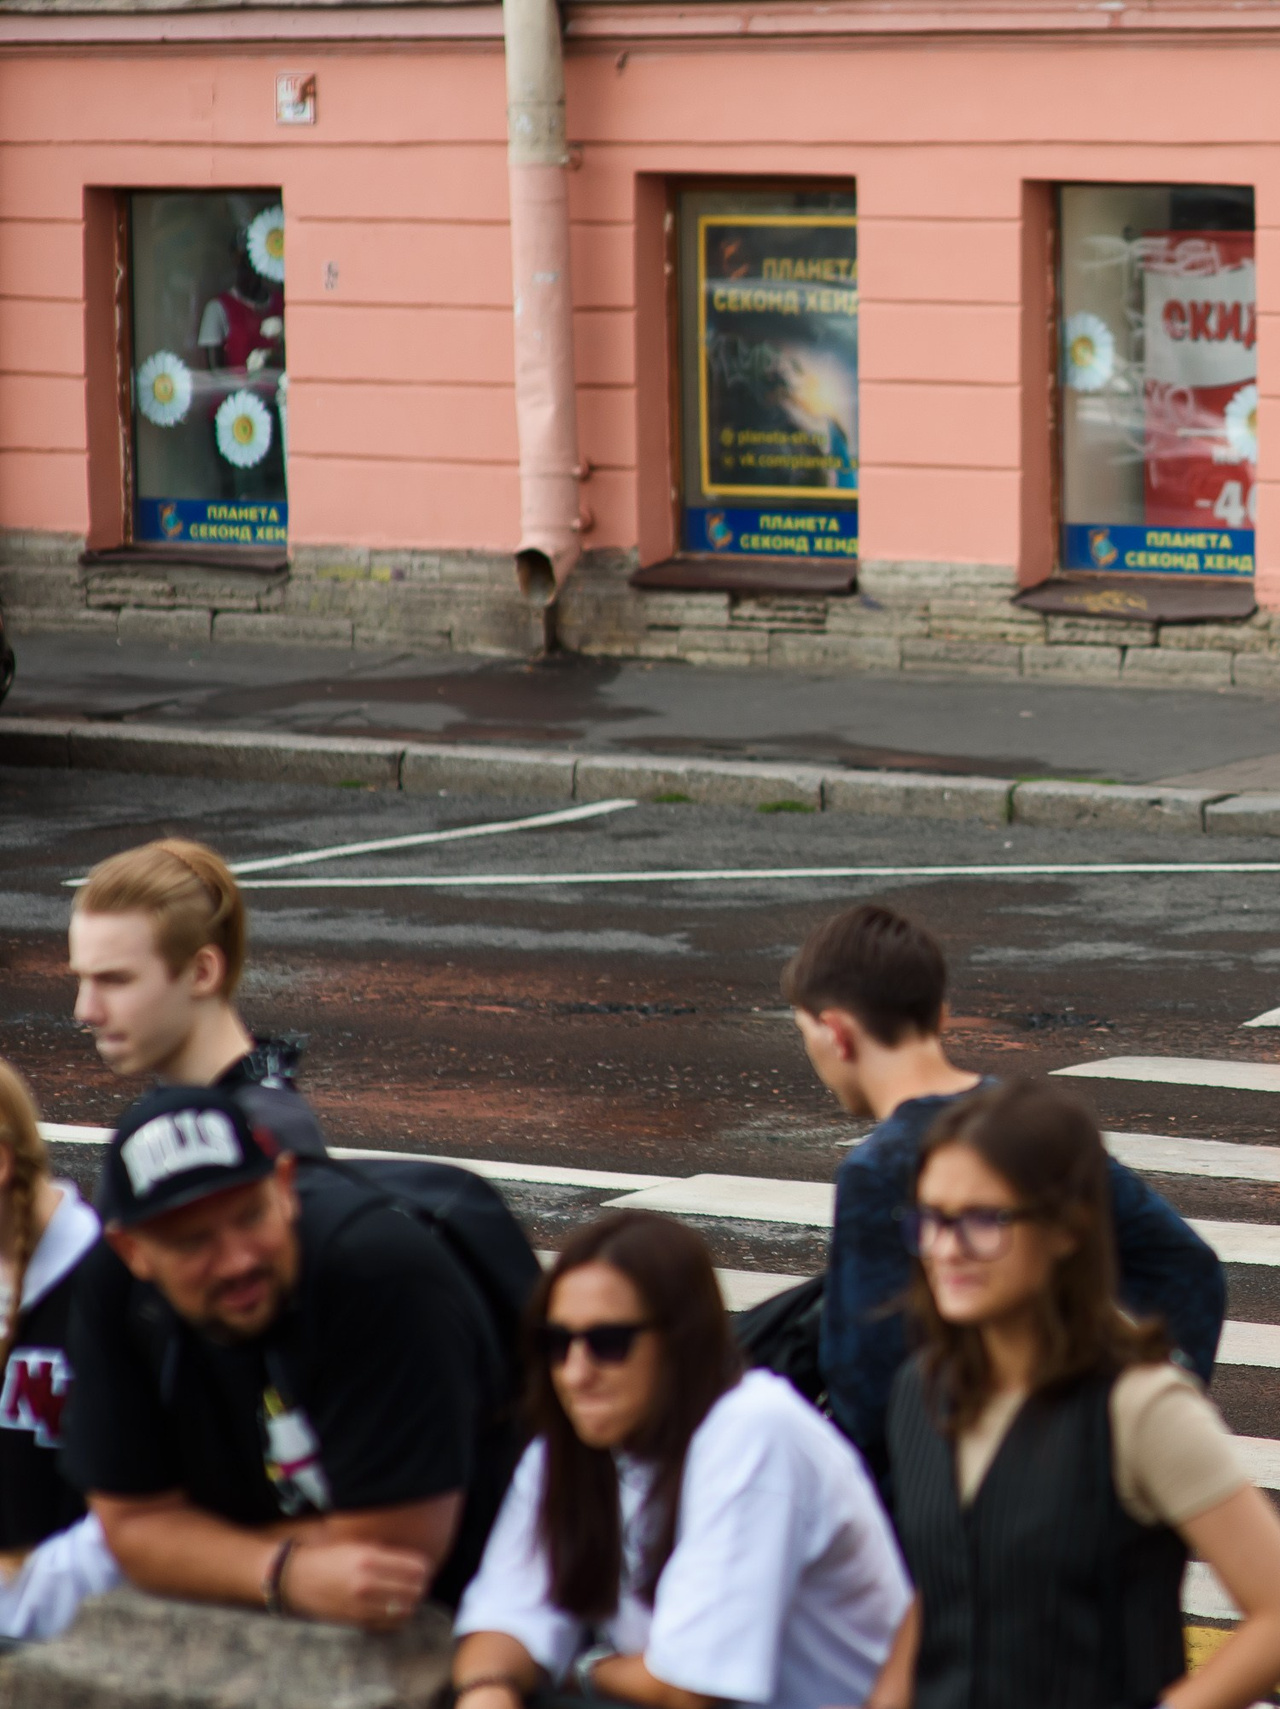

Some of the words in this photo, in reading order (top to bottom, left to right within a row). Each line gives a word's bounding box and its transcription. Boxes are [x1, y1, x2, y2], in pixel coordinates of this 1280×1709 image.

[713, 288, 800, 316] СЕКОНД
[207, 505, 280, 523] ПЛАНЕТА
[759, 514, 840, 532] ПЛАНЕТА
[189, 523, 253, 542] СЕКОНД
[255, 525, 288, 541] ХЕН
[1146, 531, 1233, 549] ПЛАНЕТА
[740, 534, 810, 553] СЕКОНД
[814, 536, 858, 555] ХЕНД
[1124, 551, 1200, 570] СЕКОНД
[1203, 553, 1253, 572] ХЕНД
